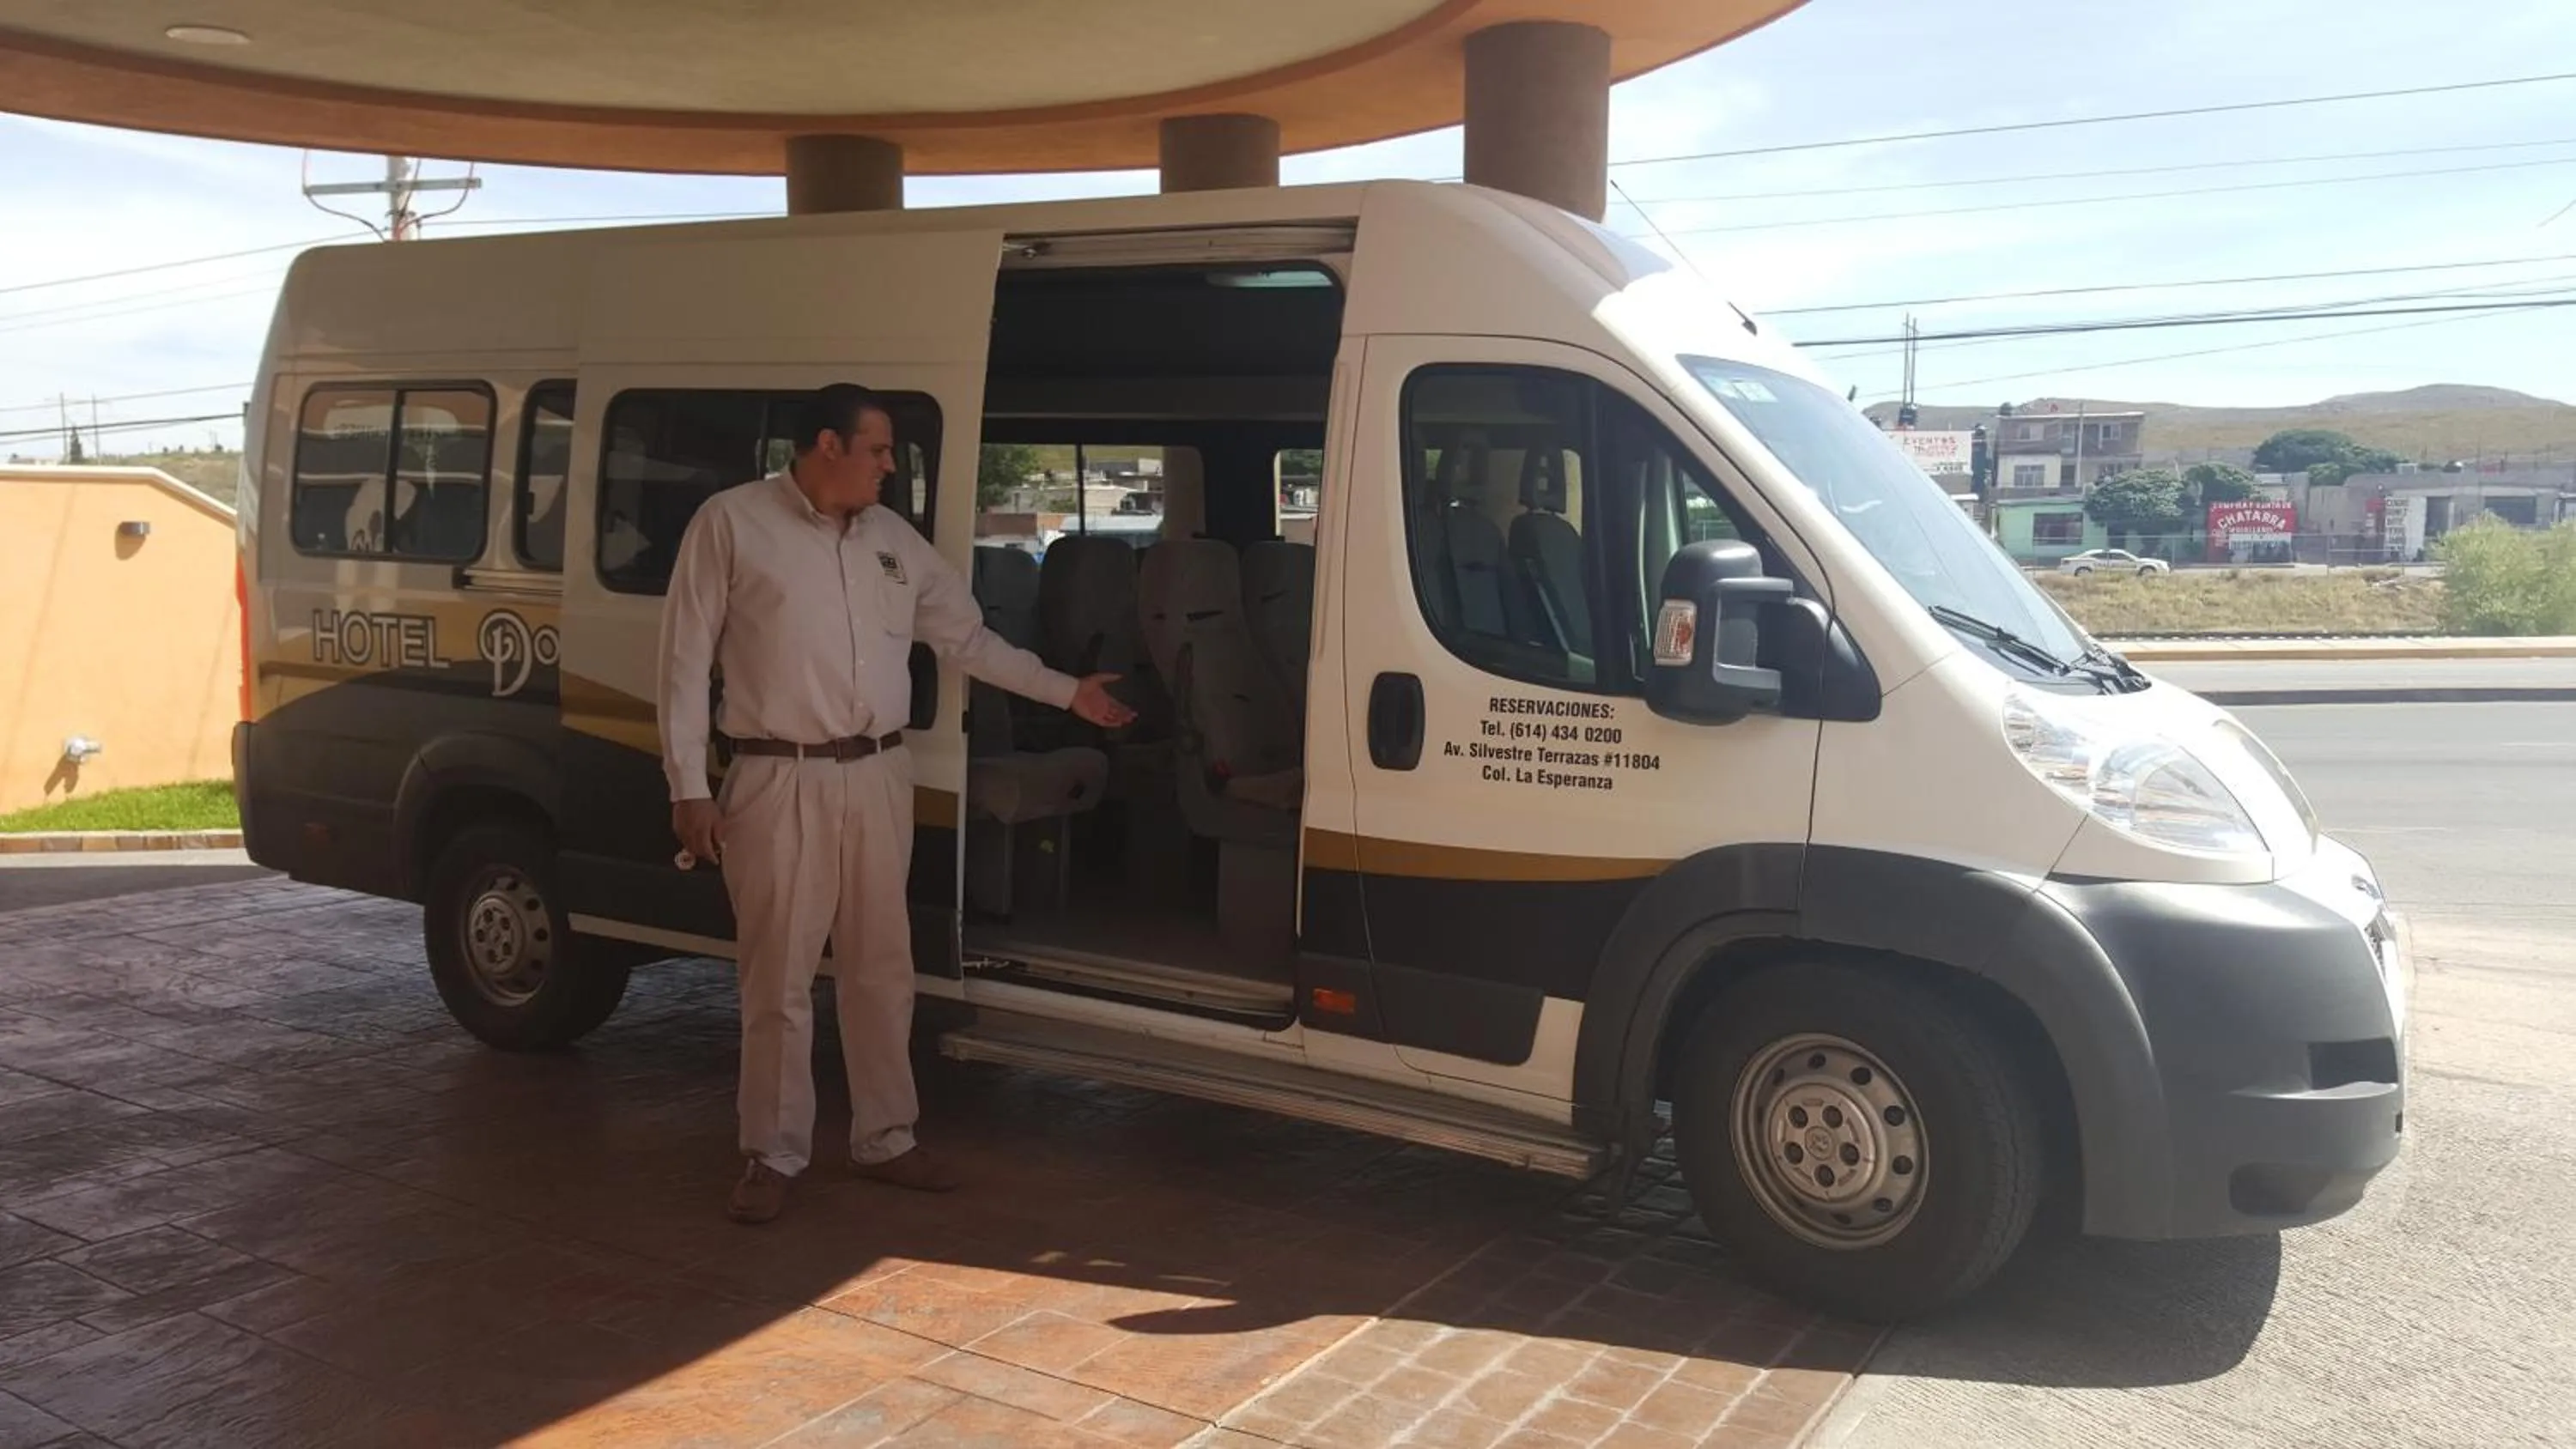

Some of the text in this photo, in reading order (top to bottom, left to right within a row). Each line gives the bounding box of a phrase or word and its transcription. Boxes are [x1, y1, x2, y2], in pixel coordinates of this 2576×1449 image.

[2217, 510, 2286, 530] CHATARRA
[313, 609, 452, 669] HOTEL
[1489, 697, 1615, 719] RESERVACIONES:
[1480, 719, 1622, 744] Tel. (614) 434 0200
[1443, 742, 1661, 771] Av. Silvestre Terrazas #11804
[1482, 765, 1613, 791] Col. La Esperanza
